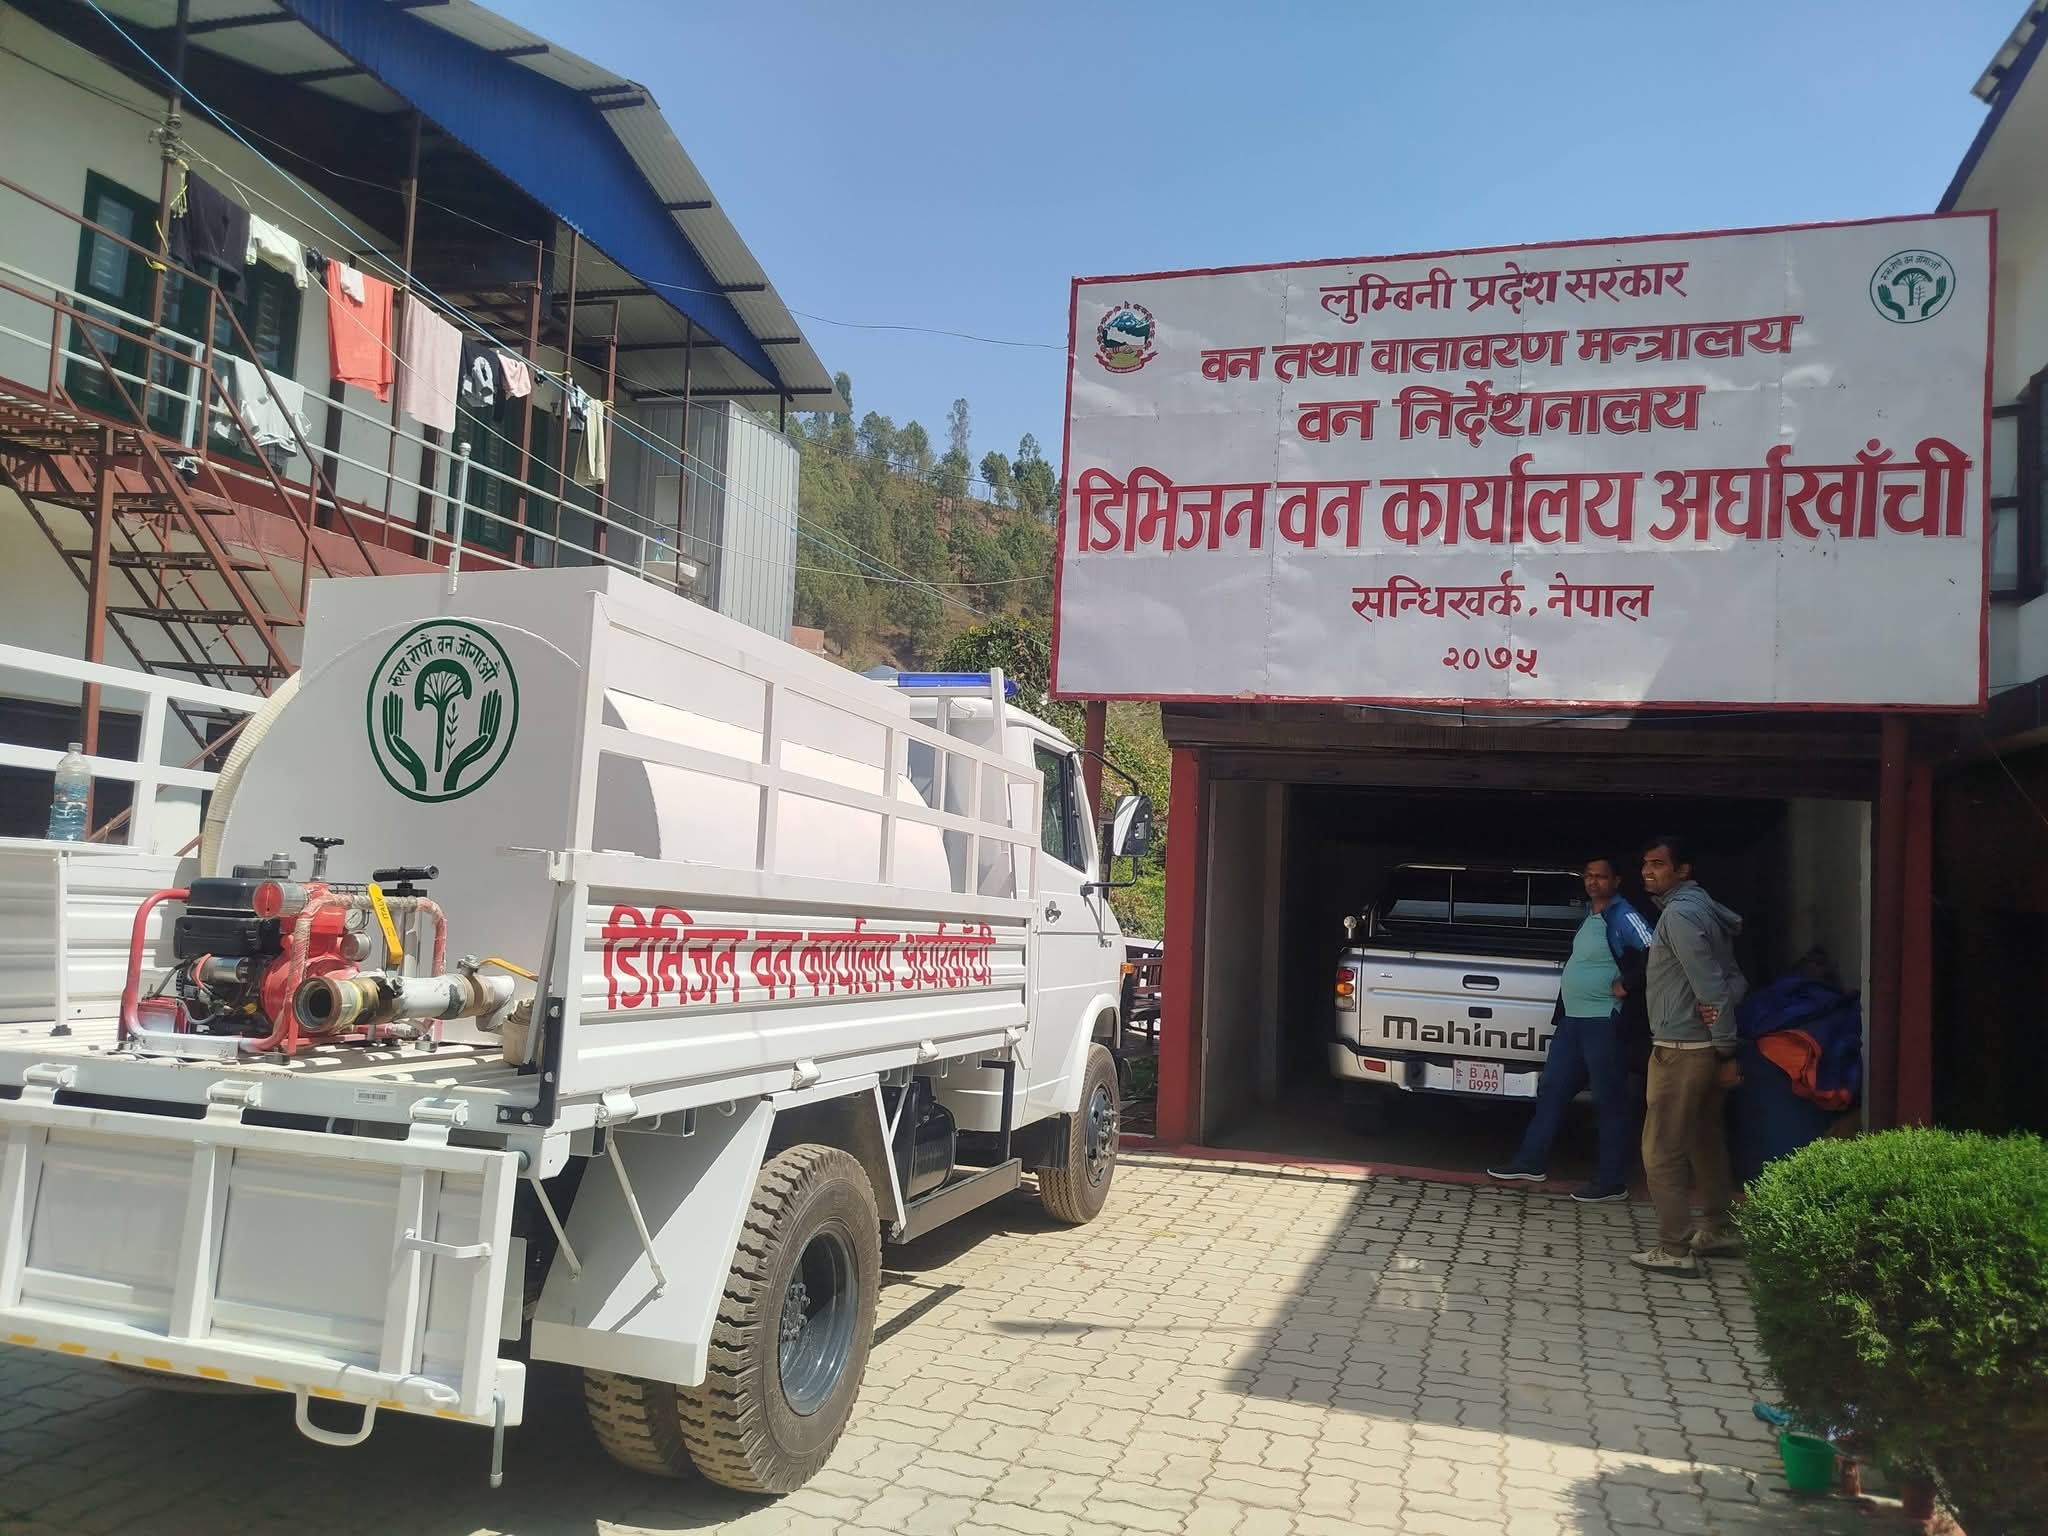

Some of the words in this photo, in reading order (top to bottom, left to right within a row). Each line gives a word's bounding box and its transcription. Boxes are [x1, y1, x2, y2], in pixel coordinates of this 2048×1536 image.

[1319, 266, 1457, 324] लुम्बिनी
[1463, 261, 1562, 314] प्रदेश
[1566, 261, 1690, 303] सरकार
[1200, 346, 1266, 383] वन
[1272, 341, 1365, 384] तथा
[1370, 330, 1570, 375] वातावरण
[1577, 315, 1804, 364] मन्त्रालय
[1297, 399, 1381, 443] वन
[1391, 380, 1707, 447] निर्देशनालय
[1071, 465, 1272, 553] डिभिजन
[1275, 479, 1372, 550] वन
[1379, 452, 1644, 546] कार्यालय
[1648, 436, 1973, 542] अर्घाखाँची
[1547, 571, 1655, 622] नेपाल
[437, 636, 455, 653] वन
[1442, 646, 1539, 679] २०७५
[750, 929, 804, 1000] वन
[799, 916, 901, 998] कार्यालय
[1470, 1067, 1478, 1079] B
[1483, 1068, 1499, 1081] AA
